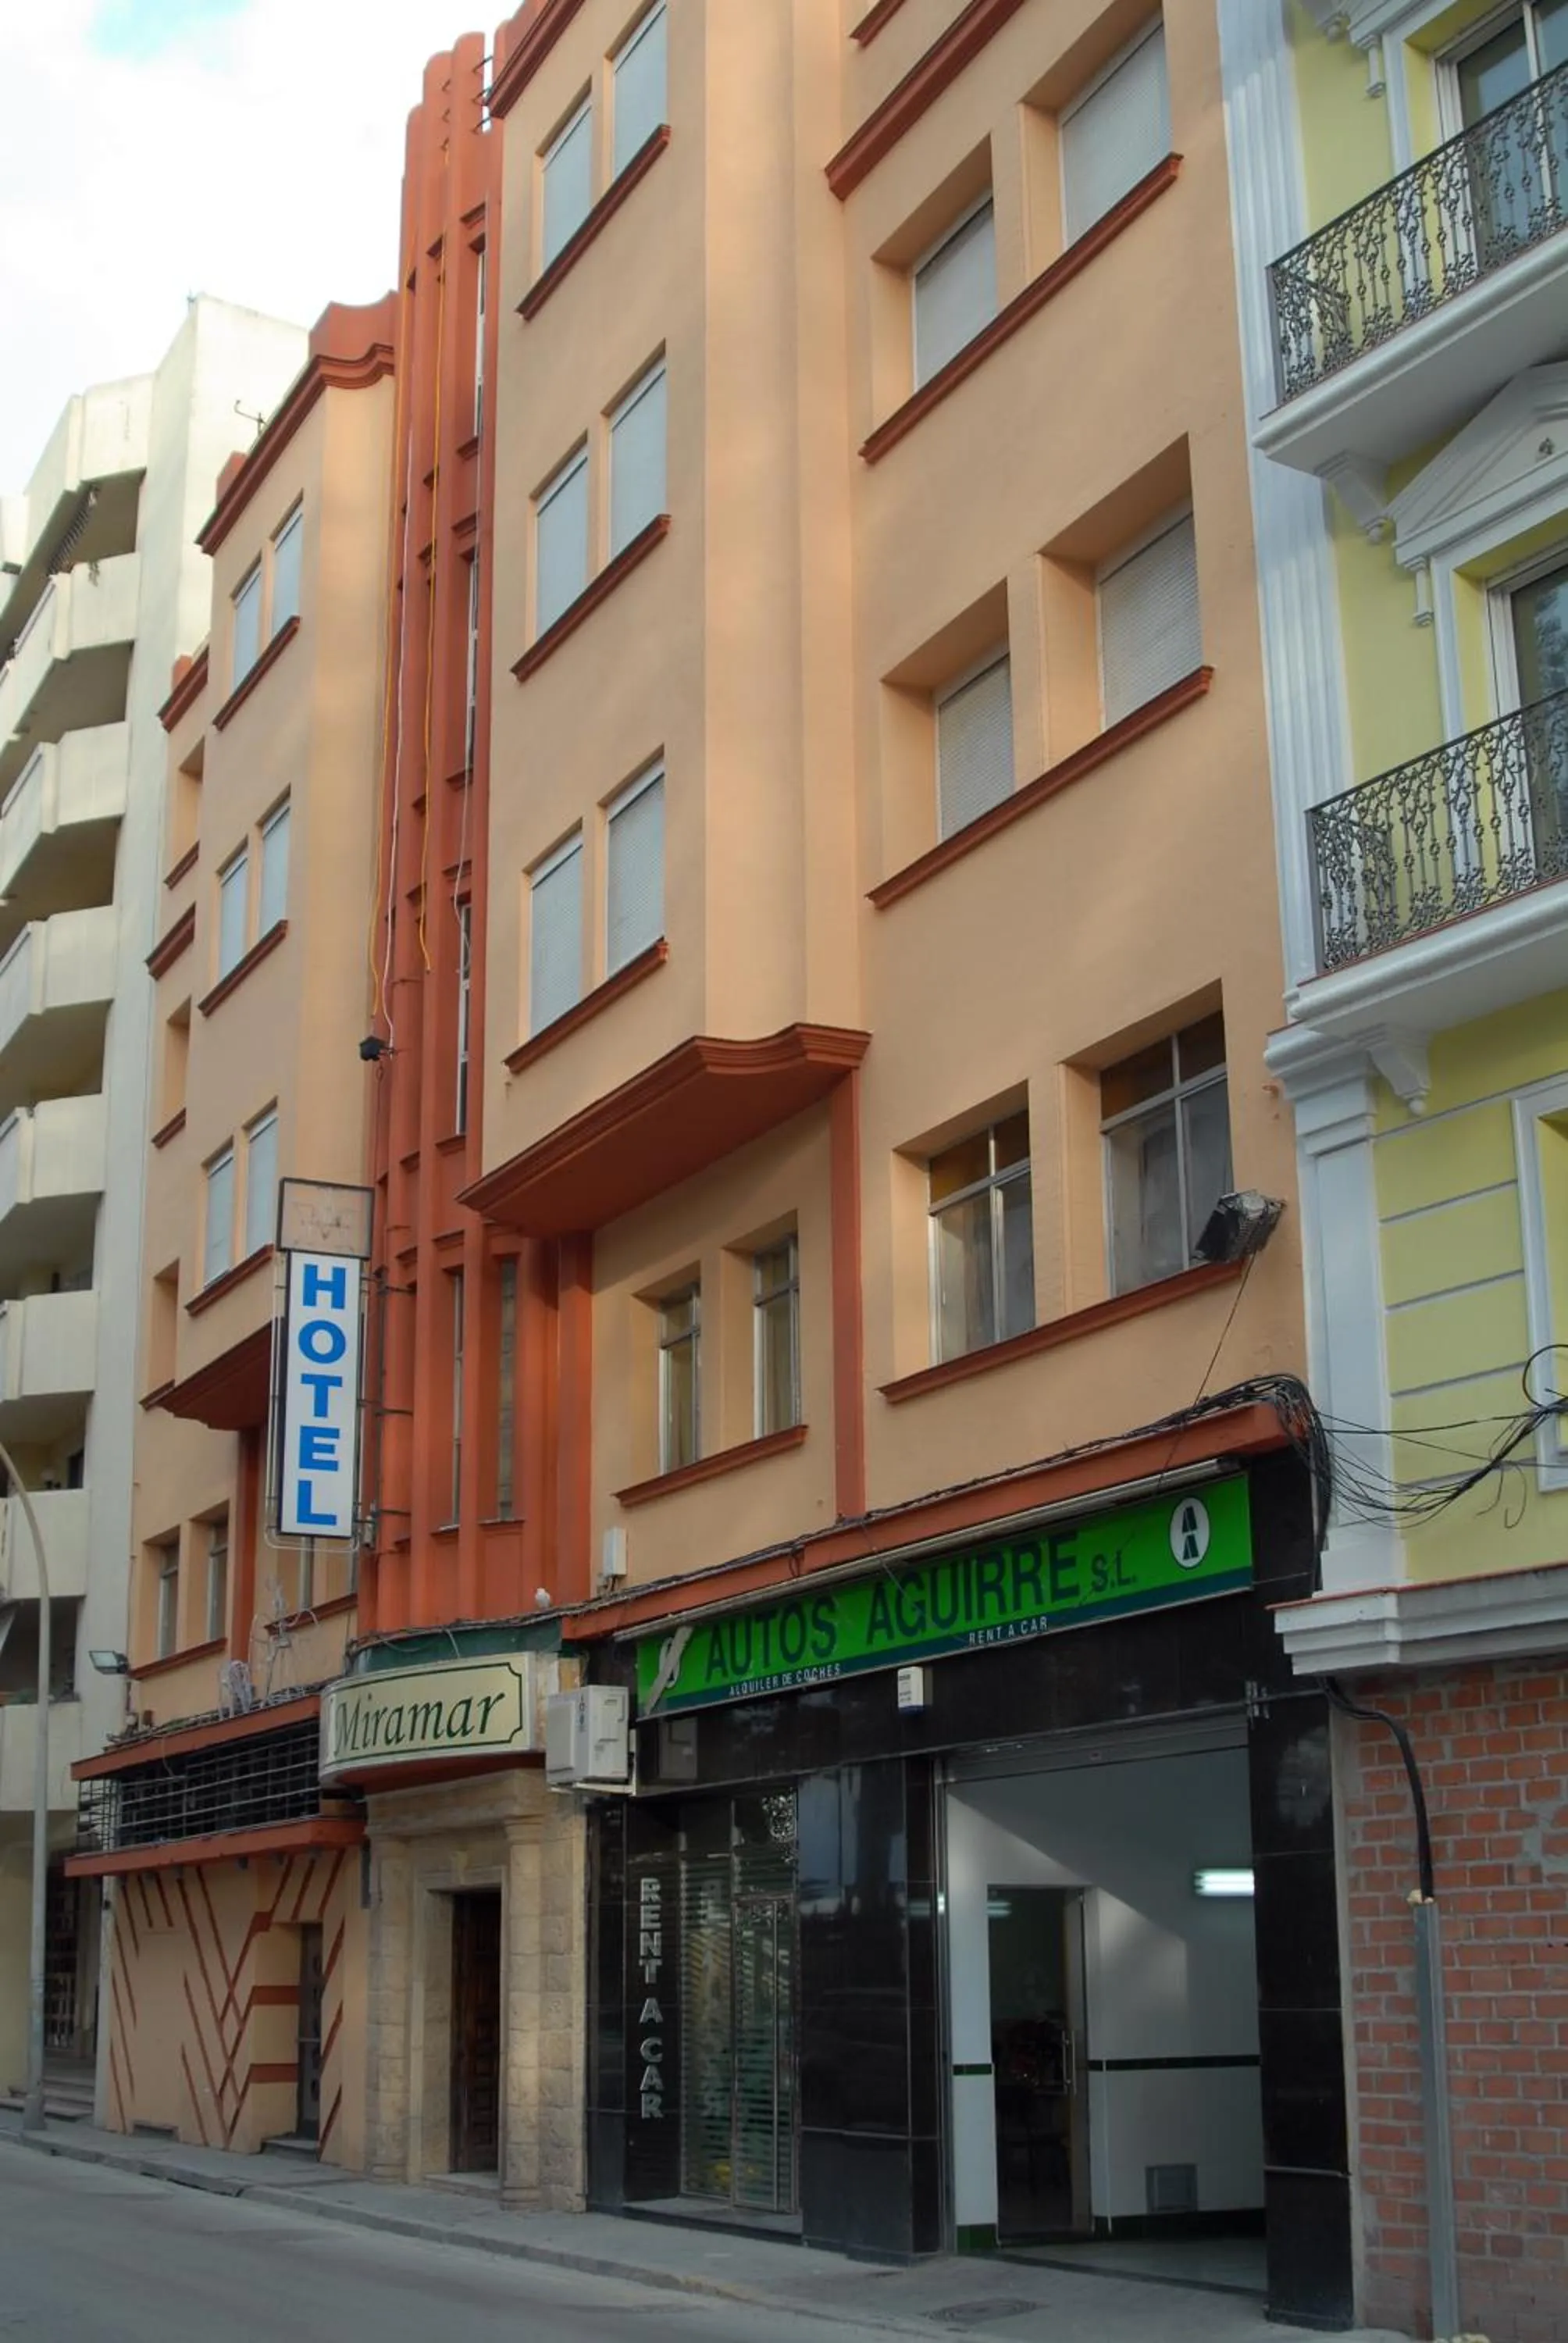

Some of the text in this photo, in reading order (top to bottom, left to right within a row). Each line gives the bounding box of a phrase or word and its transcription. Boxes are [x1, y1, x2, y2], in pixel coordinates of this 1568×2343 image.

[296, 1263, 347, 1527] HOTEL
[705, 1596, 837, 1683] AUTOS
[865, 1530, 1081, 1646] AGUIRRE
[968, 1615, 1048, 1646] RENT A CAR
[334, 1691, 506, 1756] Miramar
[729, 1662, 841, 1697] ALQUILER DE COCHES
[639, 1877, 664, 2119] RENT A CAR
